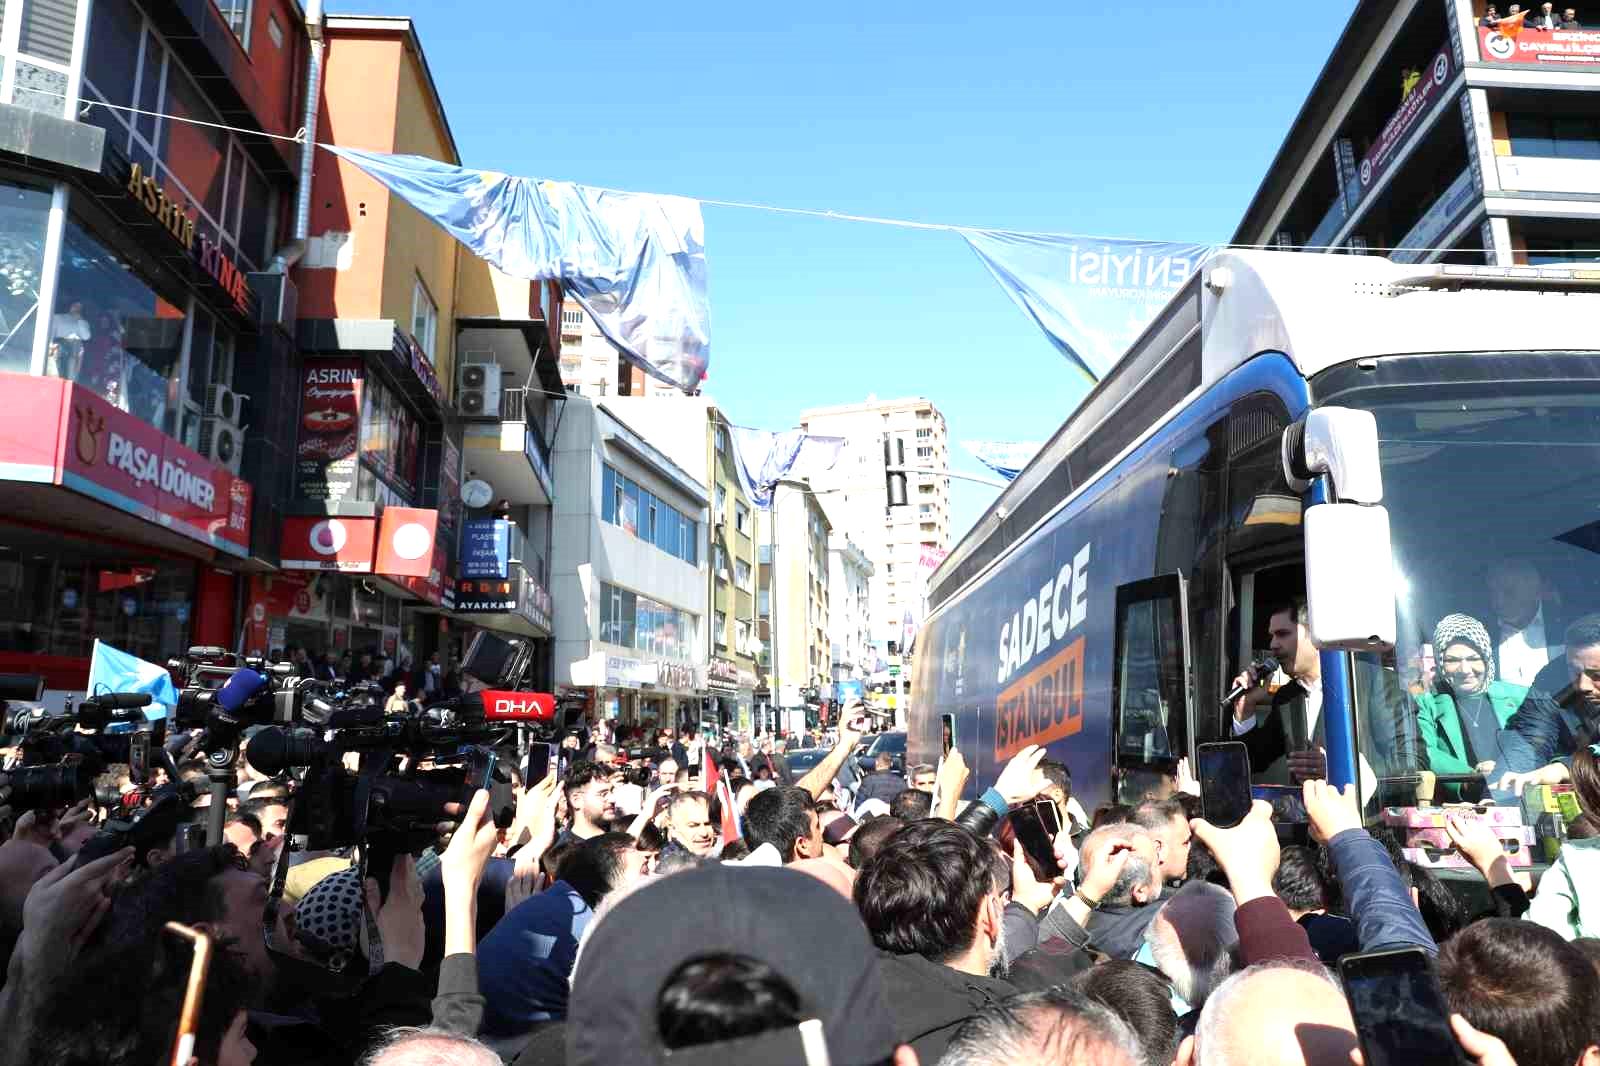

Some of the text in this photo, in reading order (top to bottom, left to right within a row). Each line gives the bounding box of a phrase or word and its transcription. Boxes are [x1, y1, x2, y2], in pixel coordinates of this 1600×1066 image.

[306, 368, 358, 384] ASRIN
[107, 431, 160, 488] PAŞA
[160, 458, 215, 513] DÖNER
[997, 541, 1092, 685] SADECE
[495, 699, 543, 715] DHA
